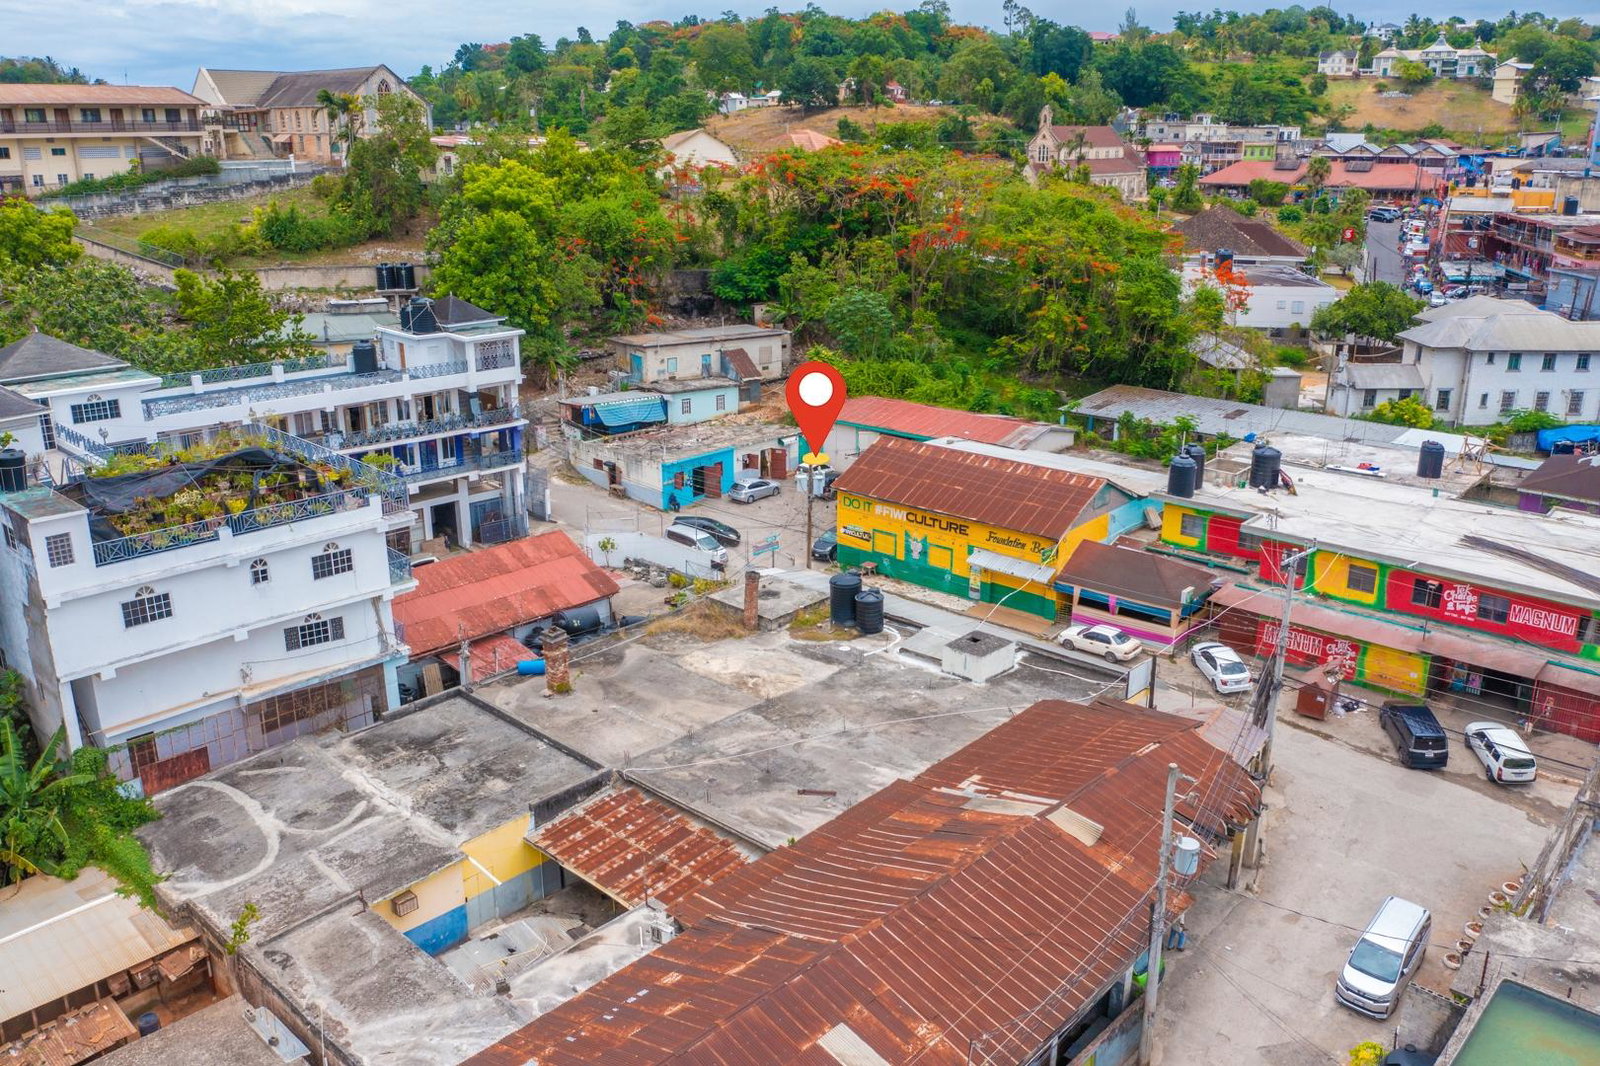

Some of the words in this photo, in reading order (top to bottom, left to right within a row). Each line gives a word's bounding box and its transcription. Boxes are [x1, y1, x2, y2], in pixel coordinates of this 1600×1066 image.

[843, 496, 860, 509] DO
[863, 501, 872, 511] IT
[1509, 604, 1577, 636] MAGNUM
